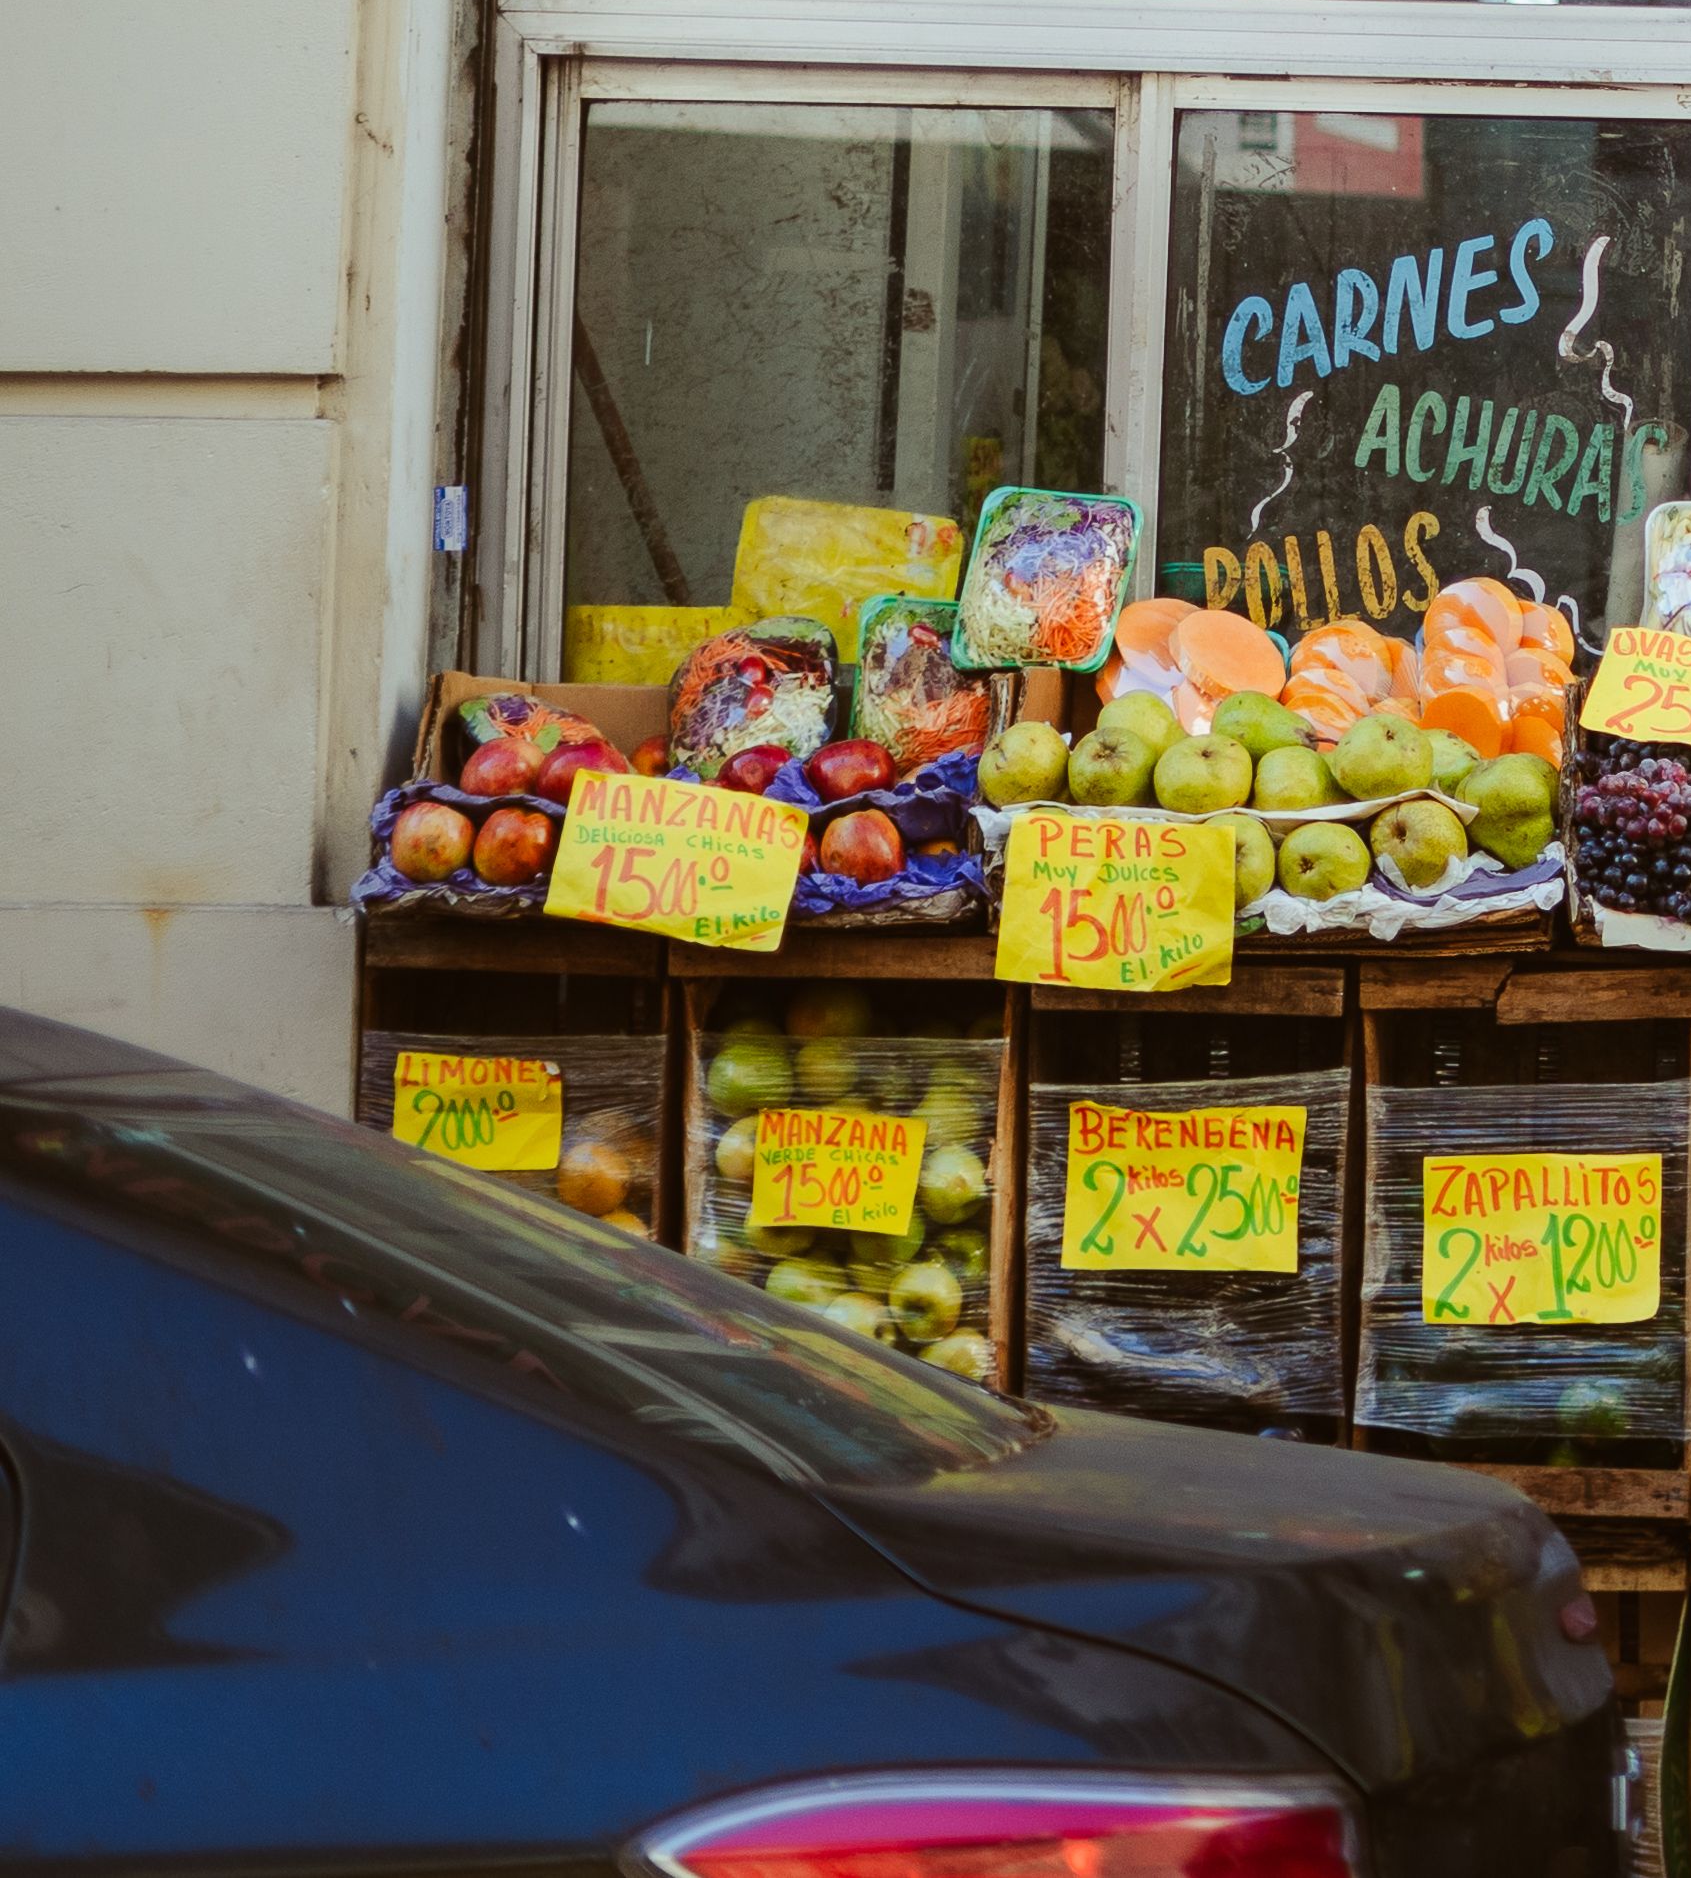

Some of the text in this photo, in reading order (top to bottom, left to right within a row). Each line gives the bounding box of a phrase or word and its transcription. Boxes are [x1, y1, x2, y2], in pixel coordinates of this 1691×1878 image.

[1221, 217, 1554, 396] CARNES
[1355, 383, 1669, 524] ACHURAS
[1204, 511, 1440, 631] POLLOS
[575, 779, 802, 850] MANZANAS
[1028, 817, 1187, 860] PERAS
[760, 1112, 910, 1157] MANZANA
[760, 1147, 816, 1165] VERDE
[1079, 1159, 1128, 1256] 2
[1432, 1226, 1482, 1318] 2
